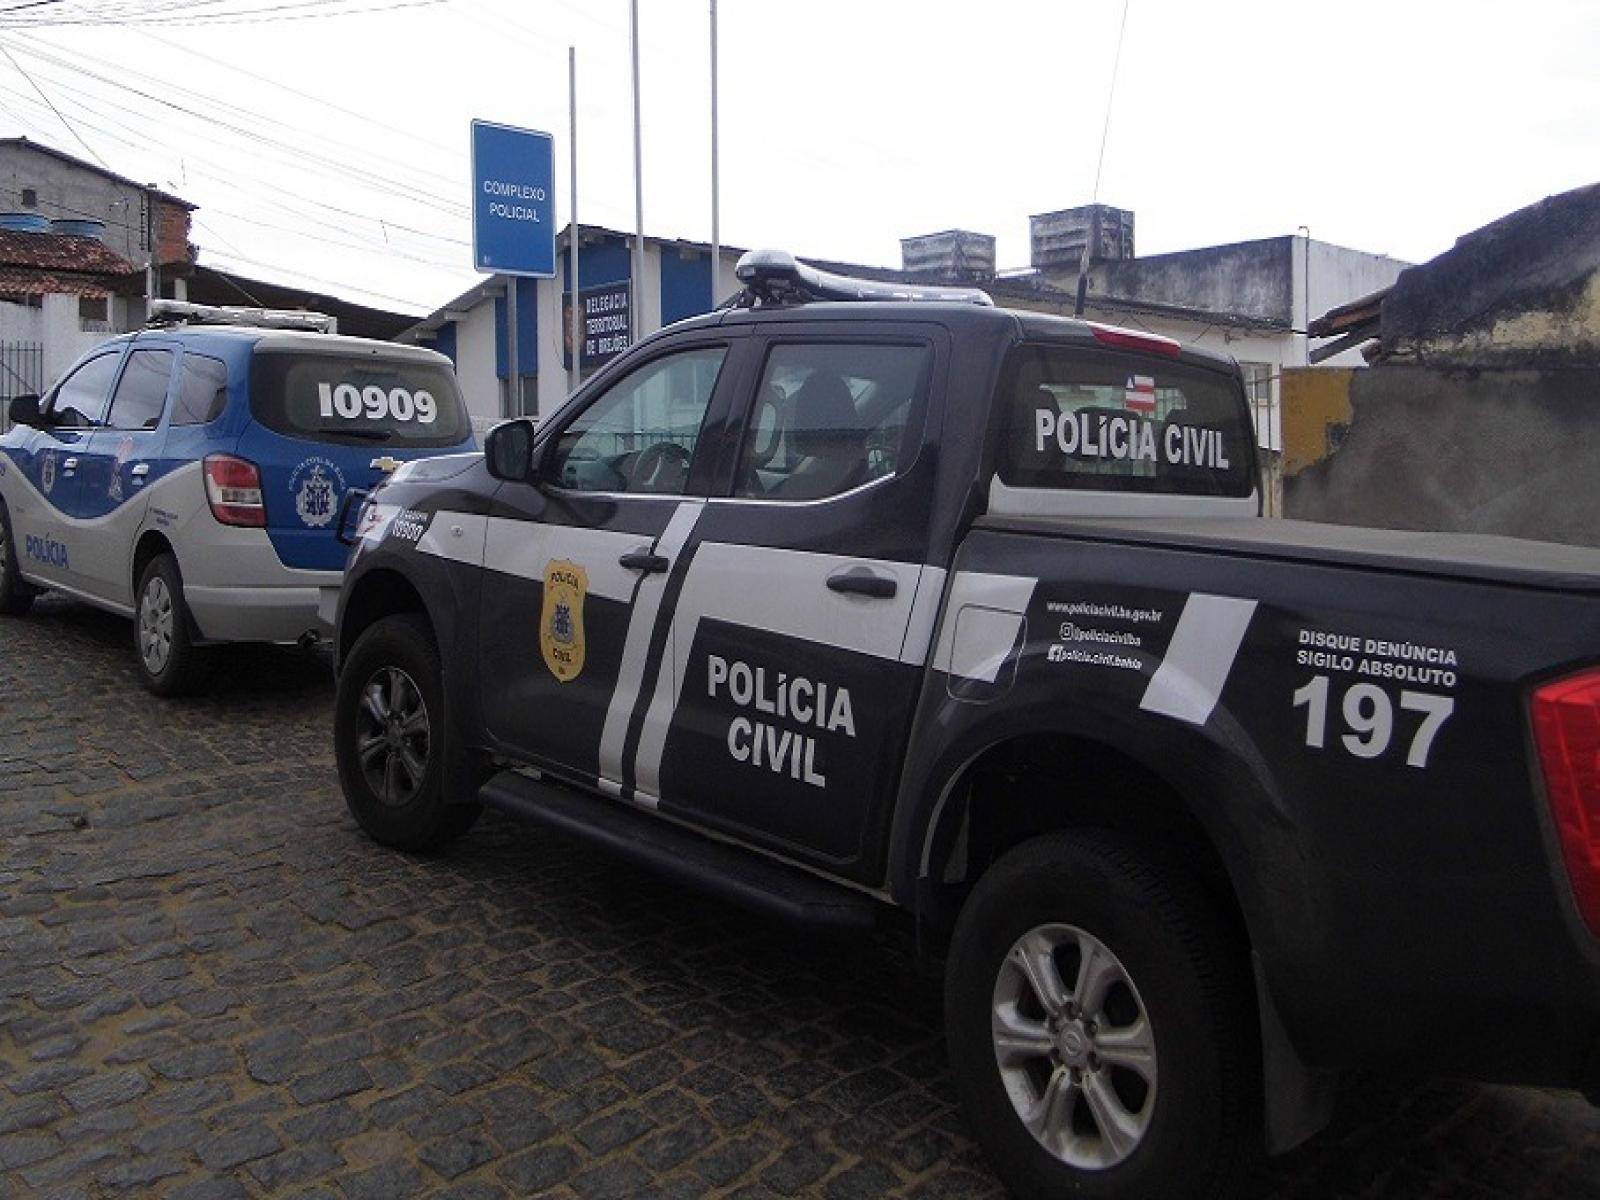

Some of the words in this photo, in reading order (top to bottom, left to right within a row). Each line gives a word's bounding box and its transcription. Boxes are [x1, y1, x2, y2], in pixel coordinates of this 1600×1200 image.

[483, 180, 545, 201] COMPLEXO
[489, 202, 540, 223] POLICIAL
[586, 314, 628, 335] TERRITORIAL
[586, 340, 596, 356] DE
[318, 382, 438, 423] 10909
[1035, 408, 1158, 462] POLÍCIA
[1164, 423, 1229, 470] CIVIL
[25, 532, 70, 569] POLÍCIA
[1298, 629, 1361, 652] DISQUE
[1364, 640, 1458, 667] DENÚNCIA
[1296, 649, 1354, 672] SIGILO
[1357, 657, 1457, 688] ABSOLUTO
[707, 653, 857, 738] POLÍCIA
[1292, 674, 1456, 769] 197
[727, 715, 827, 789] CIVIL
